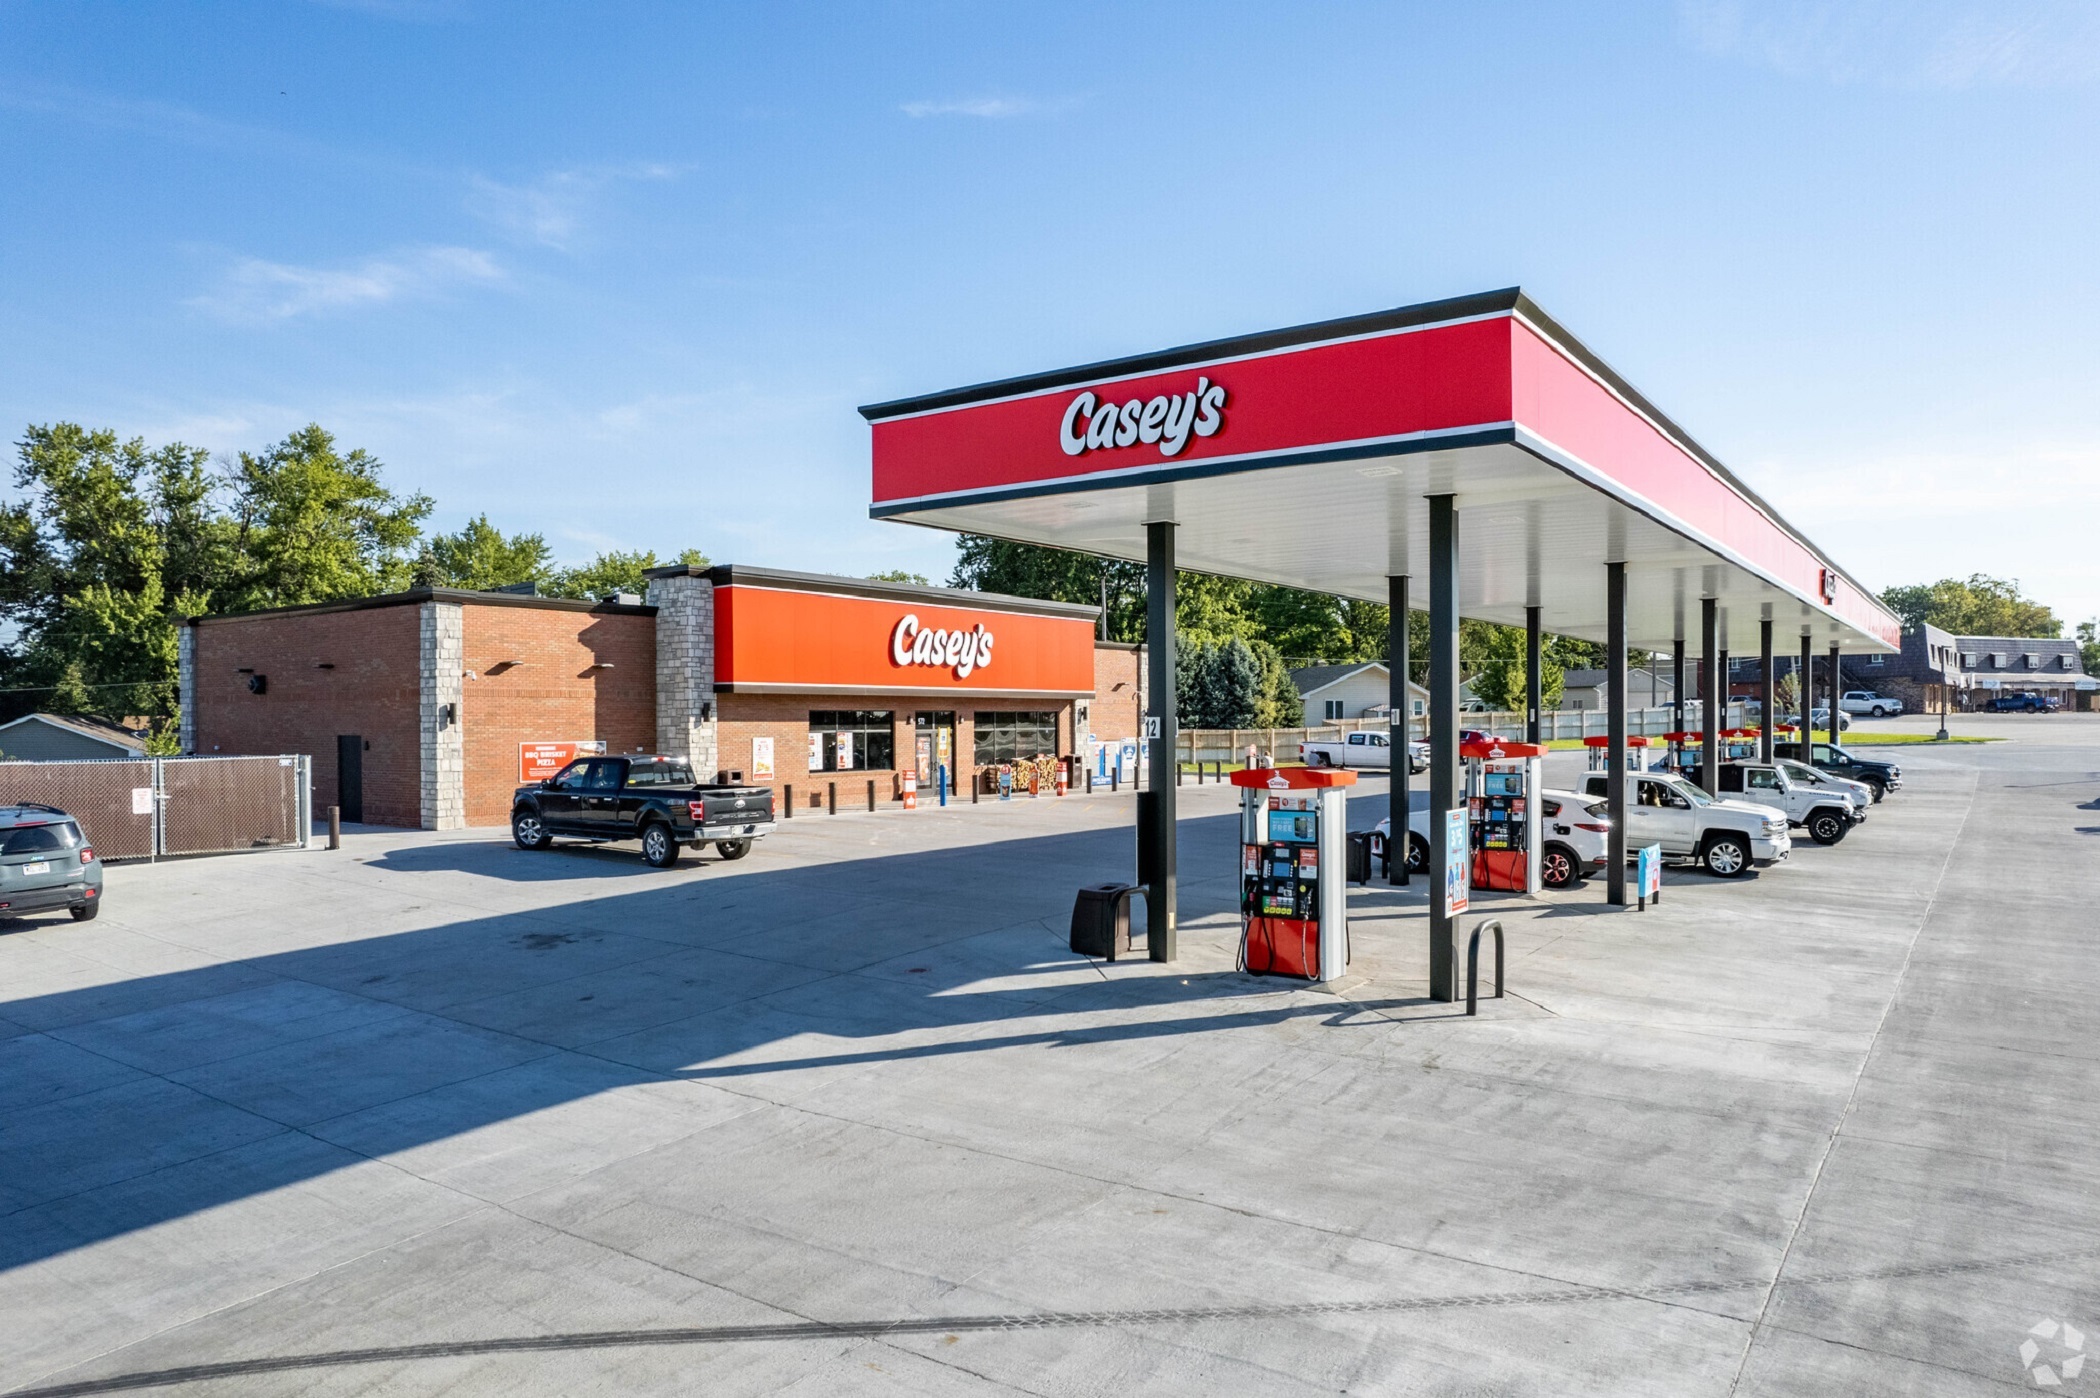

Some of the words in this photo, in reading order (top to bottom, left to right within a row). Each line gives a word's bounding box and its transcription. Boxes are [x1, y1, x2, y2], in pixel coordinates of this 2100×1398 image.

[1059, 376, 1226, 457] Casey's
[892, 613, 994, 679] Casey's
[1145, 719, 1157, 737] 12
[525, 751, 539, 759] BBQ
[537, 758, 556, 766] PIZZA
[1272, 824, 1293, 832] FREE
